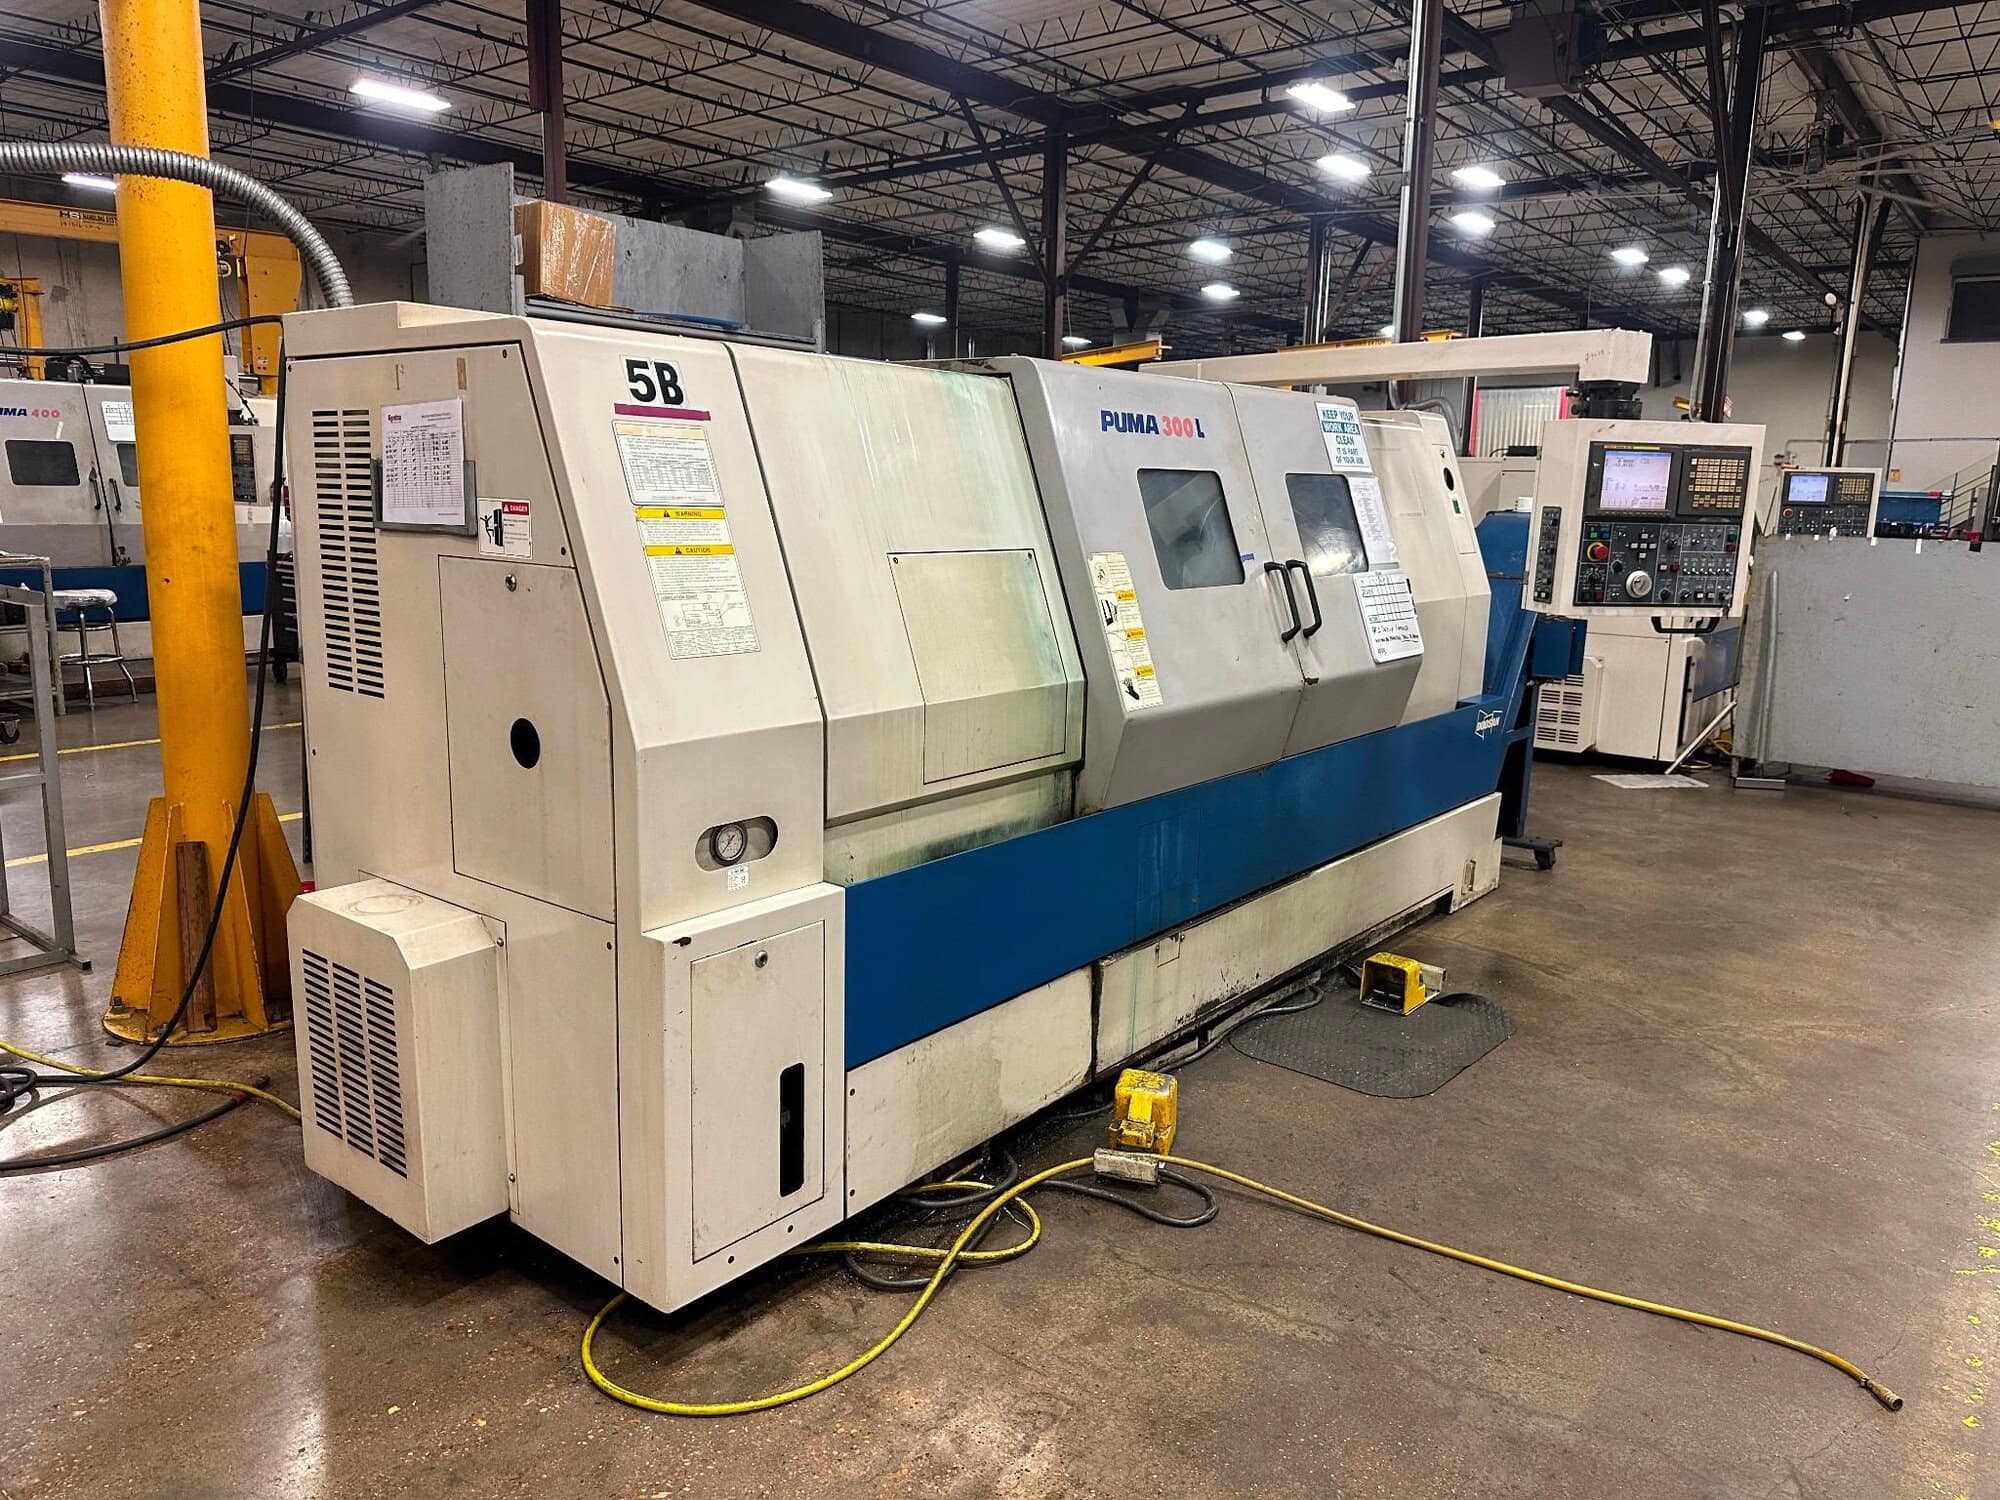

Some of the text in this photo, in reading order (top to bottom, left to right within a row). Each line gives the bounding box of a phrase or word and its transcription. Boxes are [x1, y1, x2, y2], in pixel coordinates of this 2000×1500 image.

[625, 358, 684, 406] 5B
[0, 407, 60, 418] MA 400
[1321, 409, 1354, 421] KEEP YOUR
[1100, 409, 1205, 438] PUMA 300 L
[1323, 421, 1360, 434] WORK AREA
[1335, 435, 1355, 446] CLEAN
[509, 504, 528, 513] DANGER
[675, 510, 703, 518] WARNING
[685, 546, 711, 554] CAUTION
